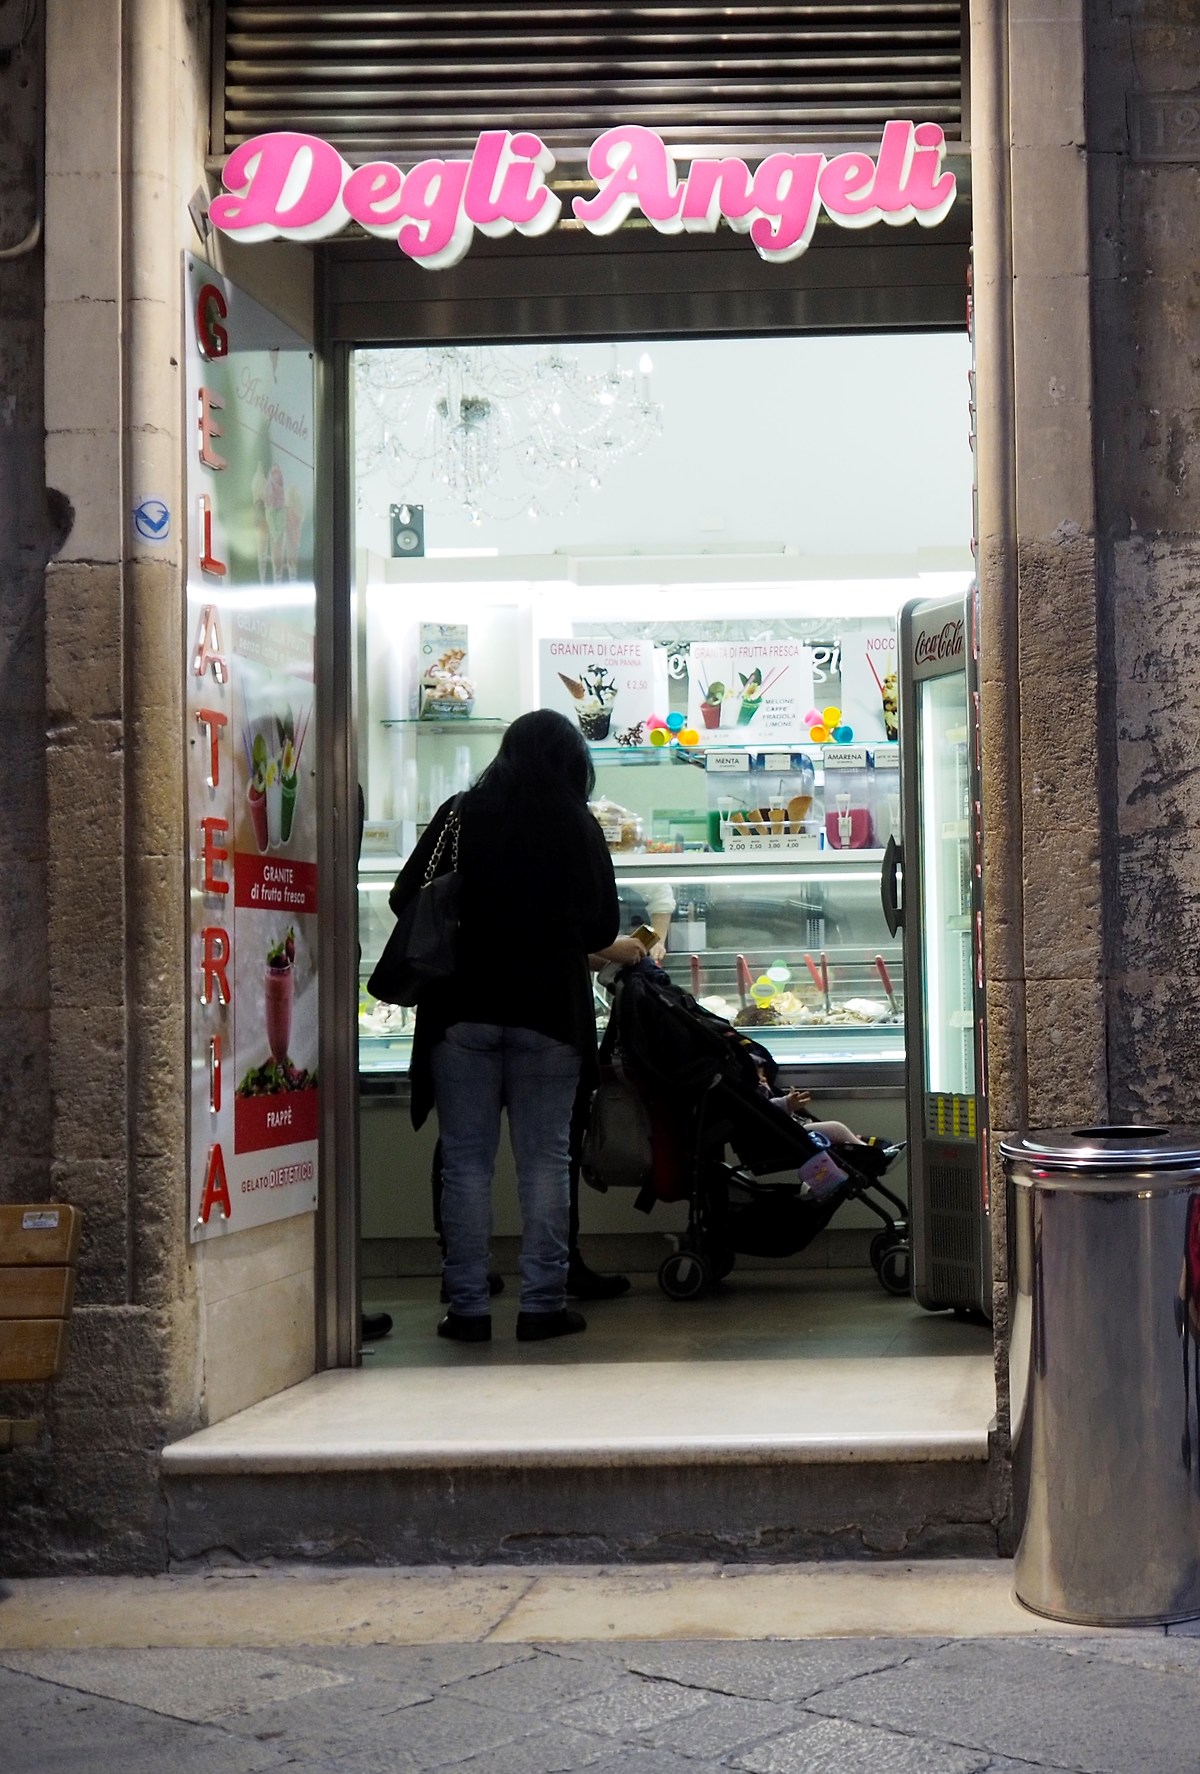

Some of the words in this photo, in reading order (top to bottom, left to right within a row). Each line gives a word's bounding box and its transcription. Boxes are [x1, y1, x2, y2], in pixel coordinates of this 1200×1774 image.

[1152, 107, 1200, 147] 12
[207, 129, 562, 270] Degli
[572, 120, 956, 264] Angeli
[550, 643, 594, 655] GRANITA
[597, 644, 607, 656] DI
[729, 647, 737, 658] DI
[739, 646, 768, 658] FRUTTA
[769, 645, 800, 657] FRESCA
[197, 283, 232, 1223] GELATERIA
[263, 865, 294, 884] GRANITE
[250, 882, 260, 900] di
[261, 883, 282, 902] frutta
[284, 886, 305, 904] fresca
[241, 1176, 269, 1193] GELATO
[269, 1161, 314, 1188] DIETETICO
